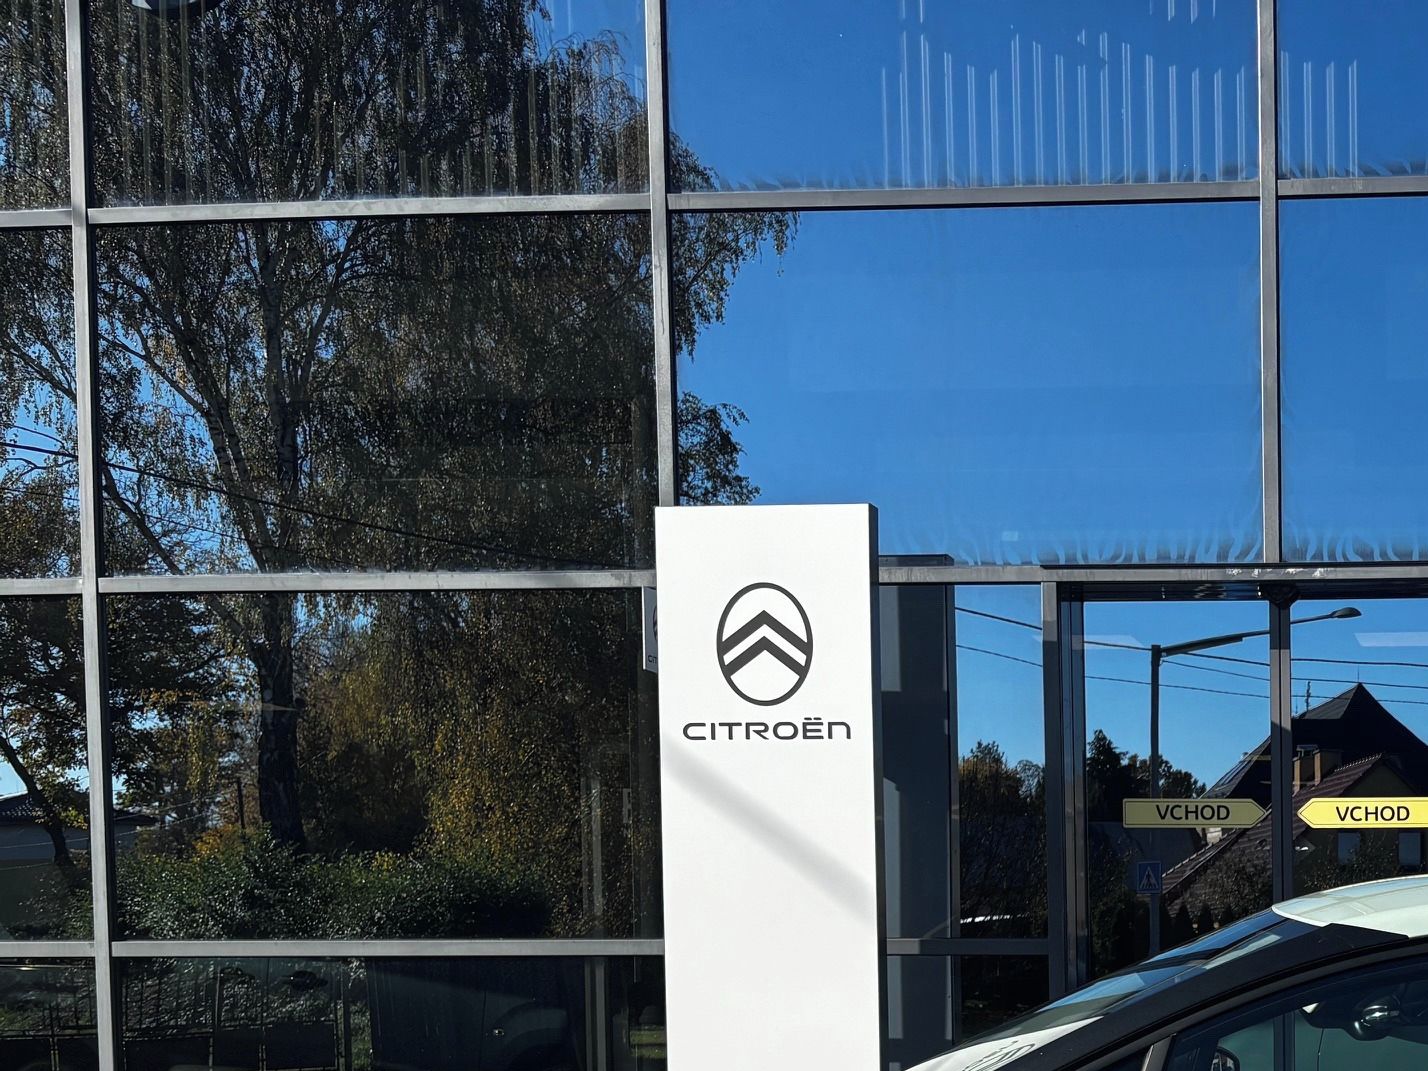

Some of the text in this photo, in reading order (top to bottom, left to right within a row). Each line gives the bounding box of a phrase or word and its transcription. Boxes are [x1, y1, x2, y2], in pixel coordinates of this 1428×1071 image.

[682, 717, 851, 741] CITROËN
[1156, 804, 1231, 821] VCHOD
[1335, 805, 1410, 822] VCHOD
